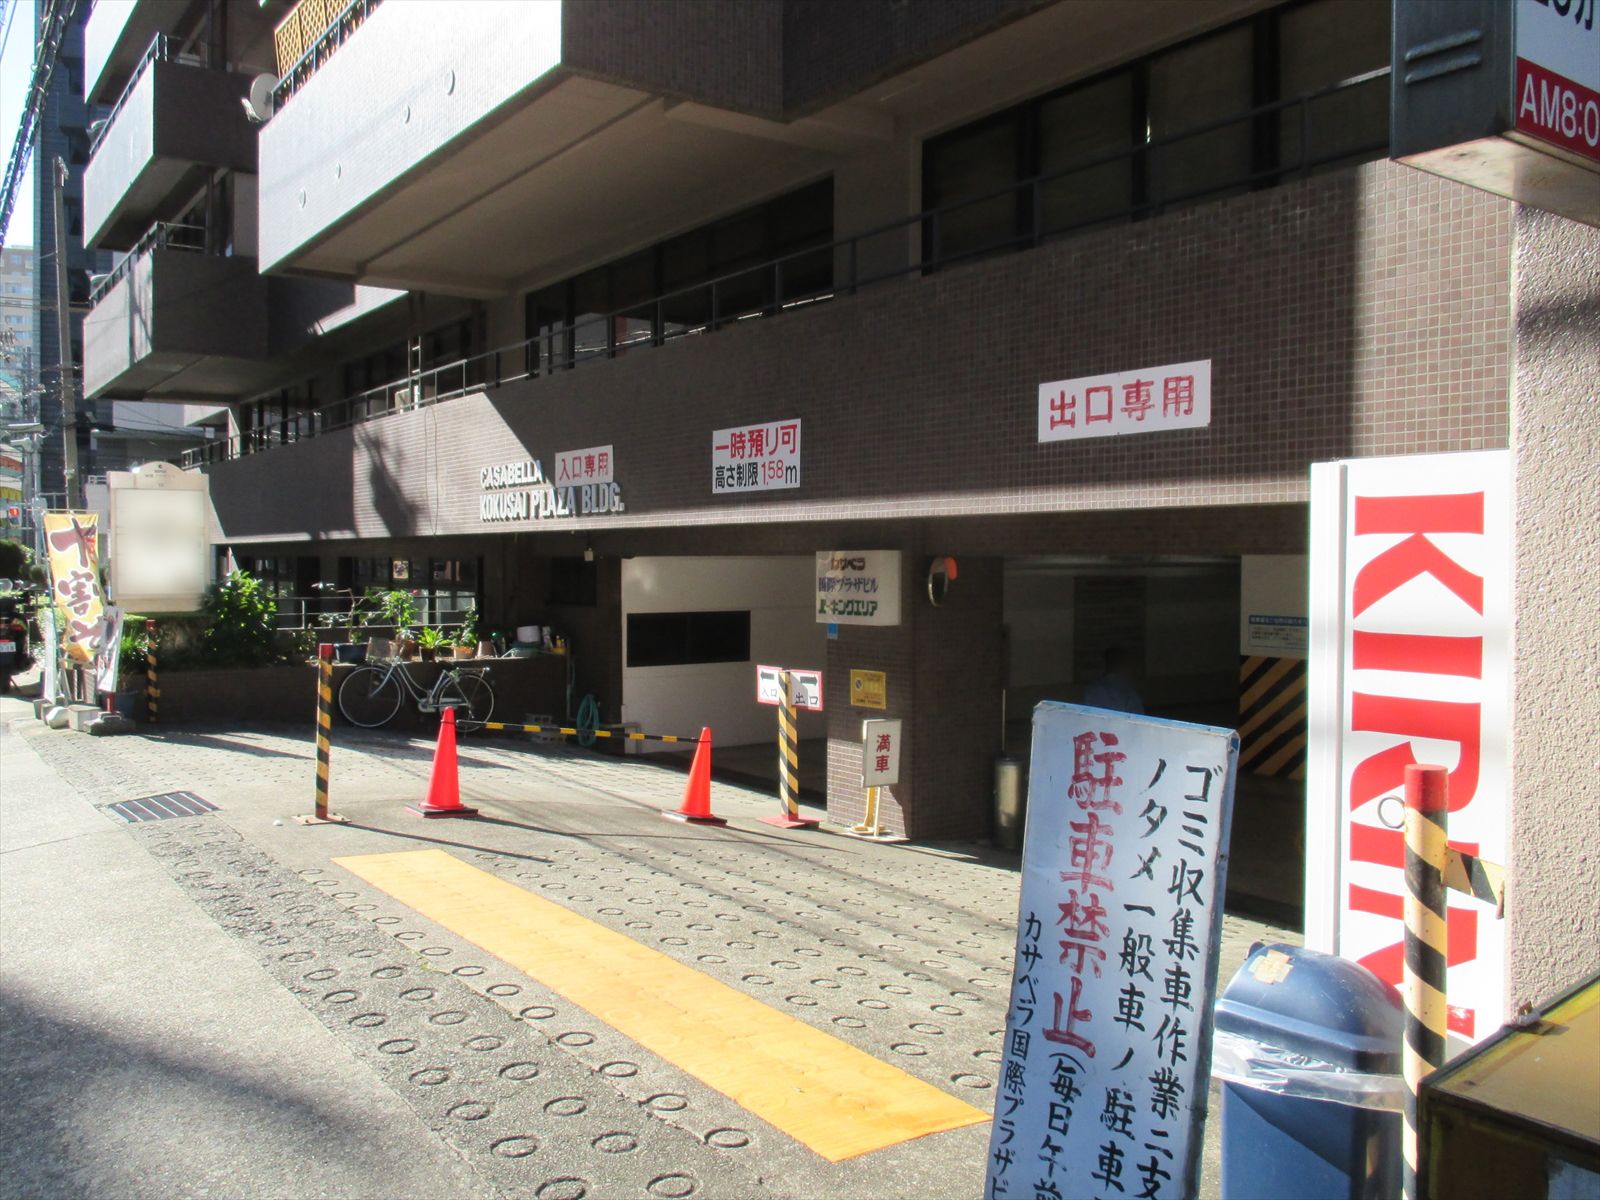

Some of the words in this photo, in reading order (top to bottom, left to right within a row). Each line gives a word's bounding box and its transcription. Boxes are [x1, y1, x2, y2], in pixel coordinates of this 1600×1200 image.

[1049, 374, 1195, 431] 出口専用
[715, 424, 798, 459] 一時預り可
[480, 460, 544, 489] CASABELLA
[559, 452, 610, 481] 入口専用
[480, 490, 528, 521] KOKUSAI
[530, 485, 577, 519] PLAZA
[581, 481, 625, 515] BLDG.
[762, 687, 778, 699] 入口
[795, 692, 819, 705] 出口
[875, 734, 891, 773] 満車
